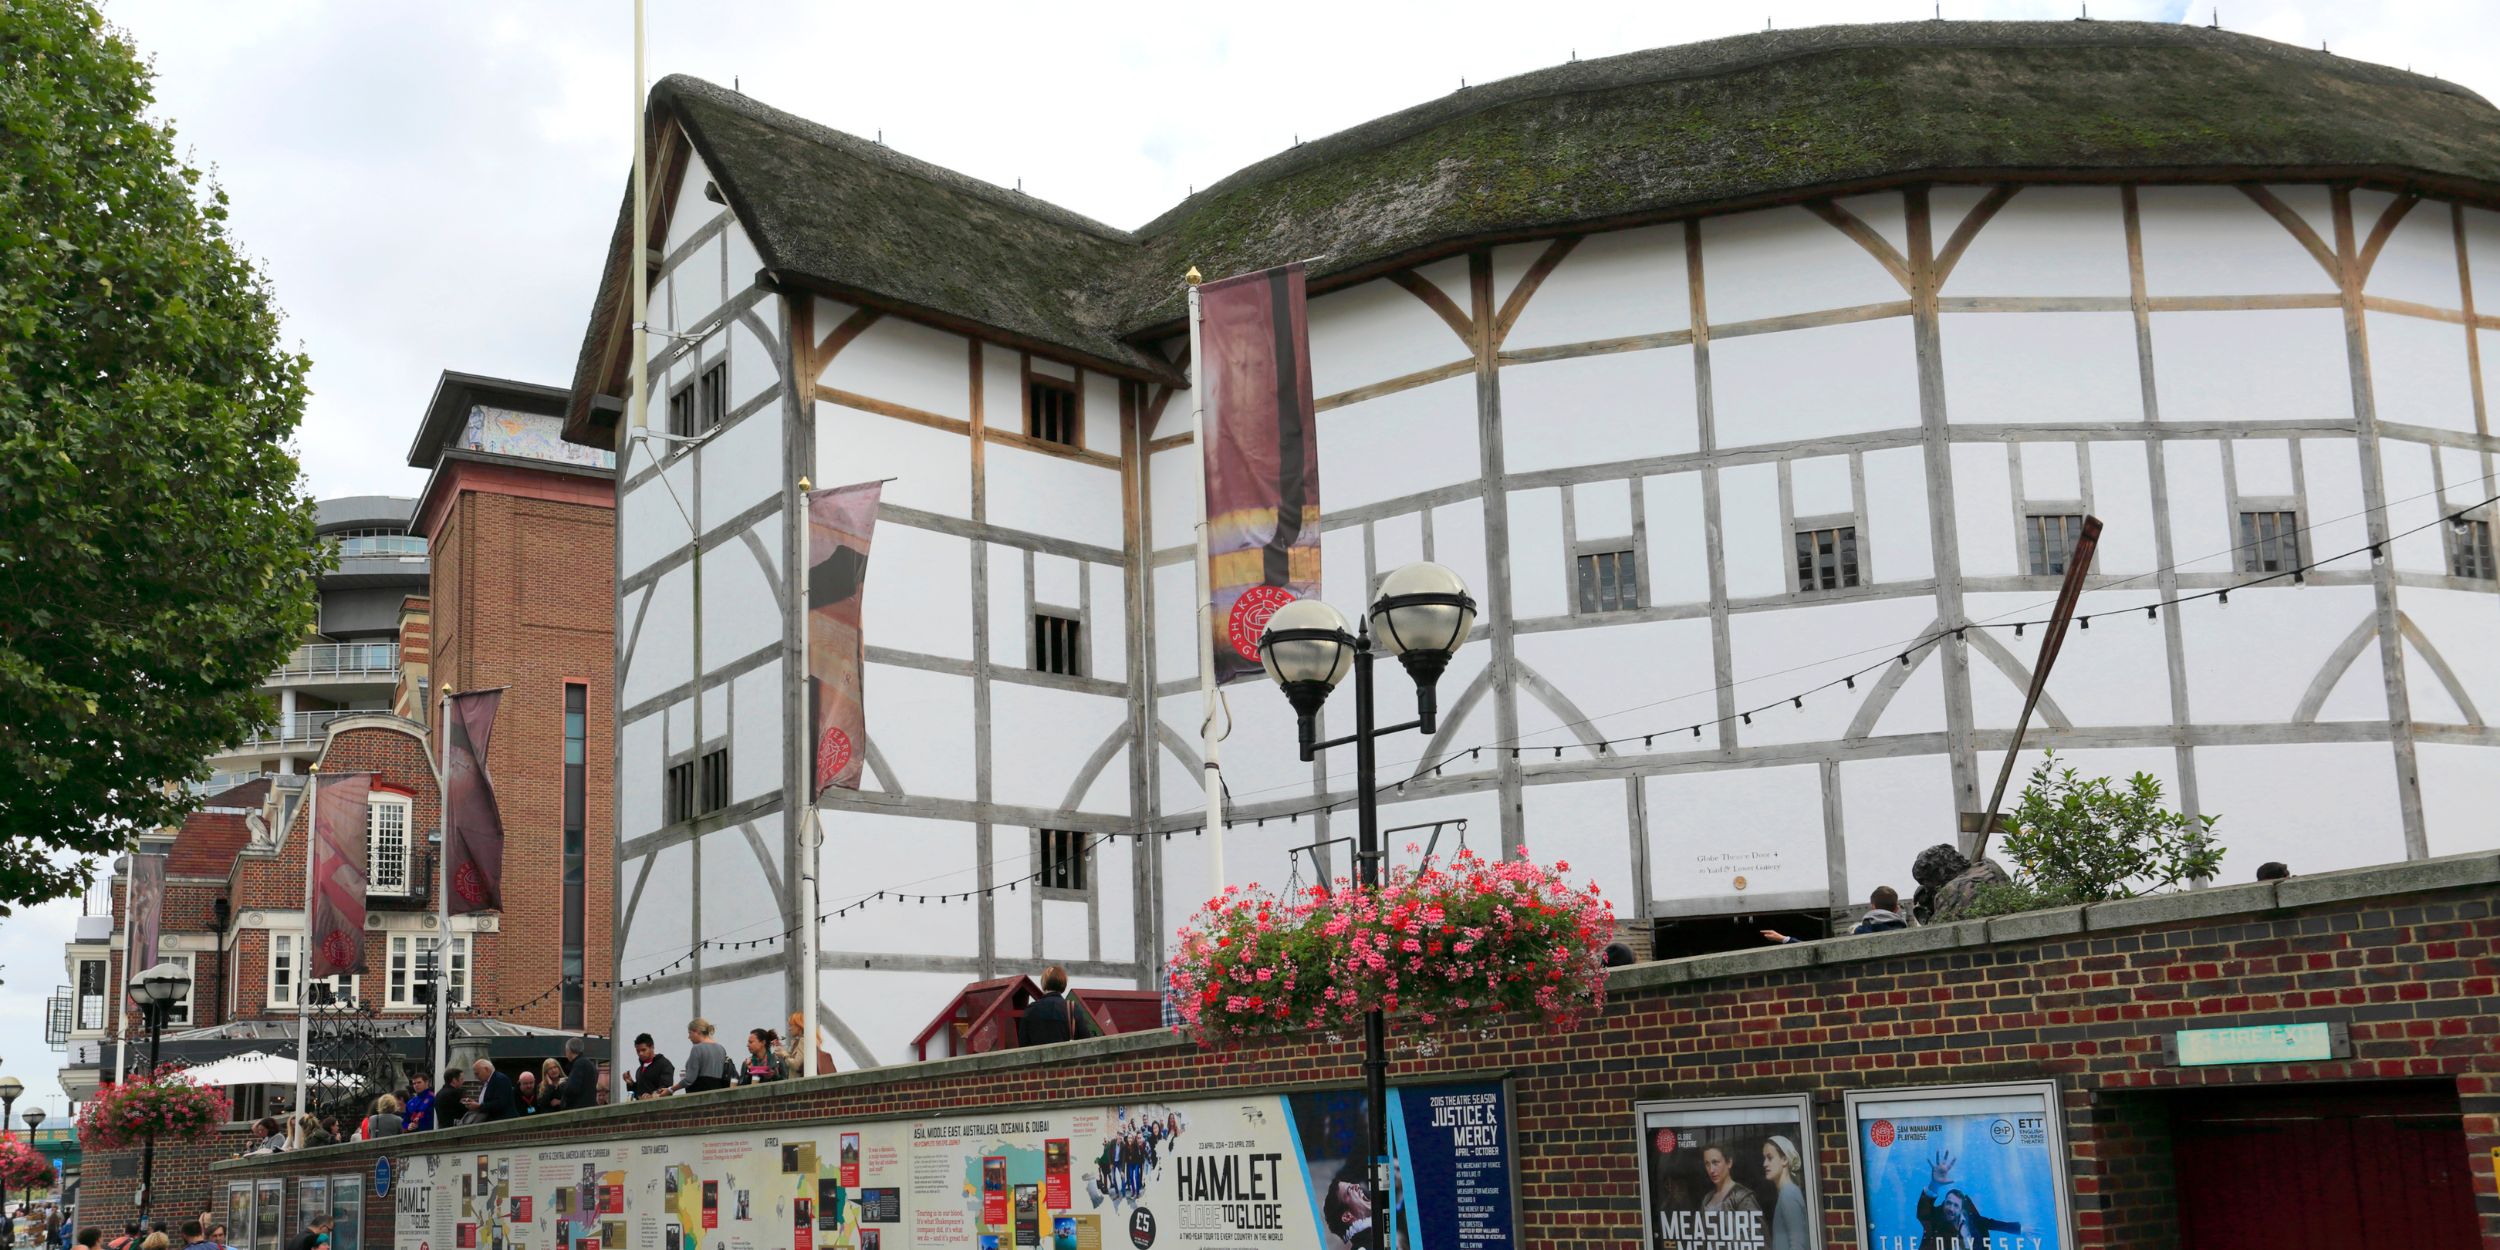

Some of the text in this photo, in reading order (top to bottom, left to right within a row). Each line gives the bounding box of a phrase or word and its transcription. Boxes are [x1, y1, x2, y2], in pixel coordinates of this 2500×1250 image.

[2219, 1025, 2317, 1046] FIRE EXIT
[1430, 1093, 1497, 1107] 2015 THEATRE SEASON
[1431, 1104, 1497, 1127] JUSTICE &
[914, 1128, 927, 1139] ASIA,
[927, 1127, 947, 1139] MIDDLE
[1001, 1122, 1024, 1135] OCEANIA
[1025, 1121, 1030, 1133] &
[1032, 1120, 1050, 1132] DUBAI
[1897, 1124, 1943, 1133] SAM WANAMAKER
[2018, 1118, 2043, 1128] ETT
[764, 1137, 779, 1147] AFRICA
[1453, 1125, 1498, 1147] MERCY
[1677, 1133, 1692, 1141] GLOBE
[1897, 1133, 1928, 1141] PLAYHOUSE
[653, 1144, 669, 1154] AMERICA
[1234, 1140, 1244, 1149] APRIL
[1678, 1140, 1697, 1148] THEATRE
[1455, 1147, 1470, 1157] APRIL
[1475, 1146, 1499, 1156] OCTOBER
[1177, 1153, 1282, 1201] HAMLET
[398, 1186, 431, 1213] HAMLET
[1136, 1211, 1150, 1233] £5
[1179, 1204, 1283, 1230] GLOBE TO GLOBE
[1660, 1210, 1765, 1240] MEASURE
[1234, 1232, 1253, 1240] COUNTRY
[1259, 1232, 1267, 1240] THE
[1268, 1232, 1283, 1240] WORLD
[1879, 1236, 2042, 1250] THE ODYSSEY
